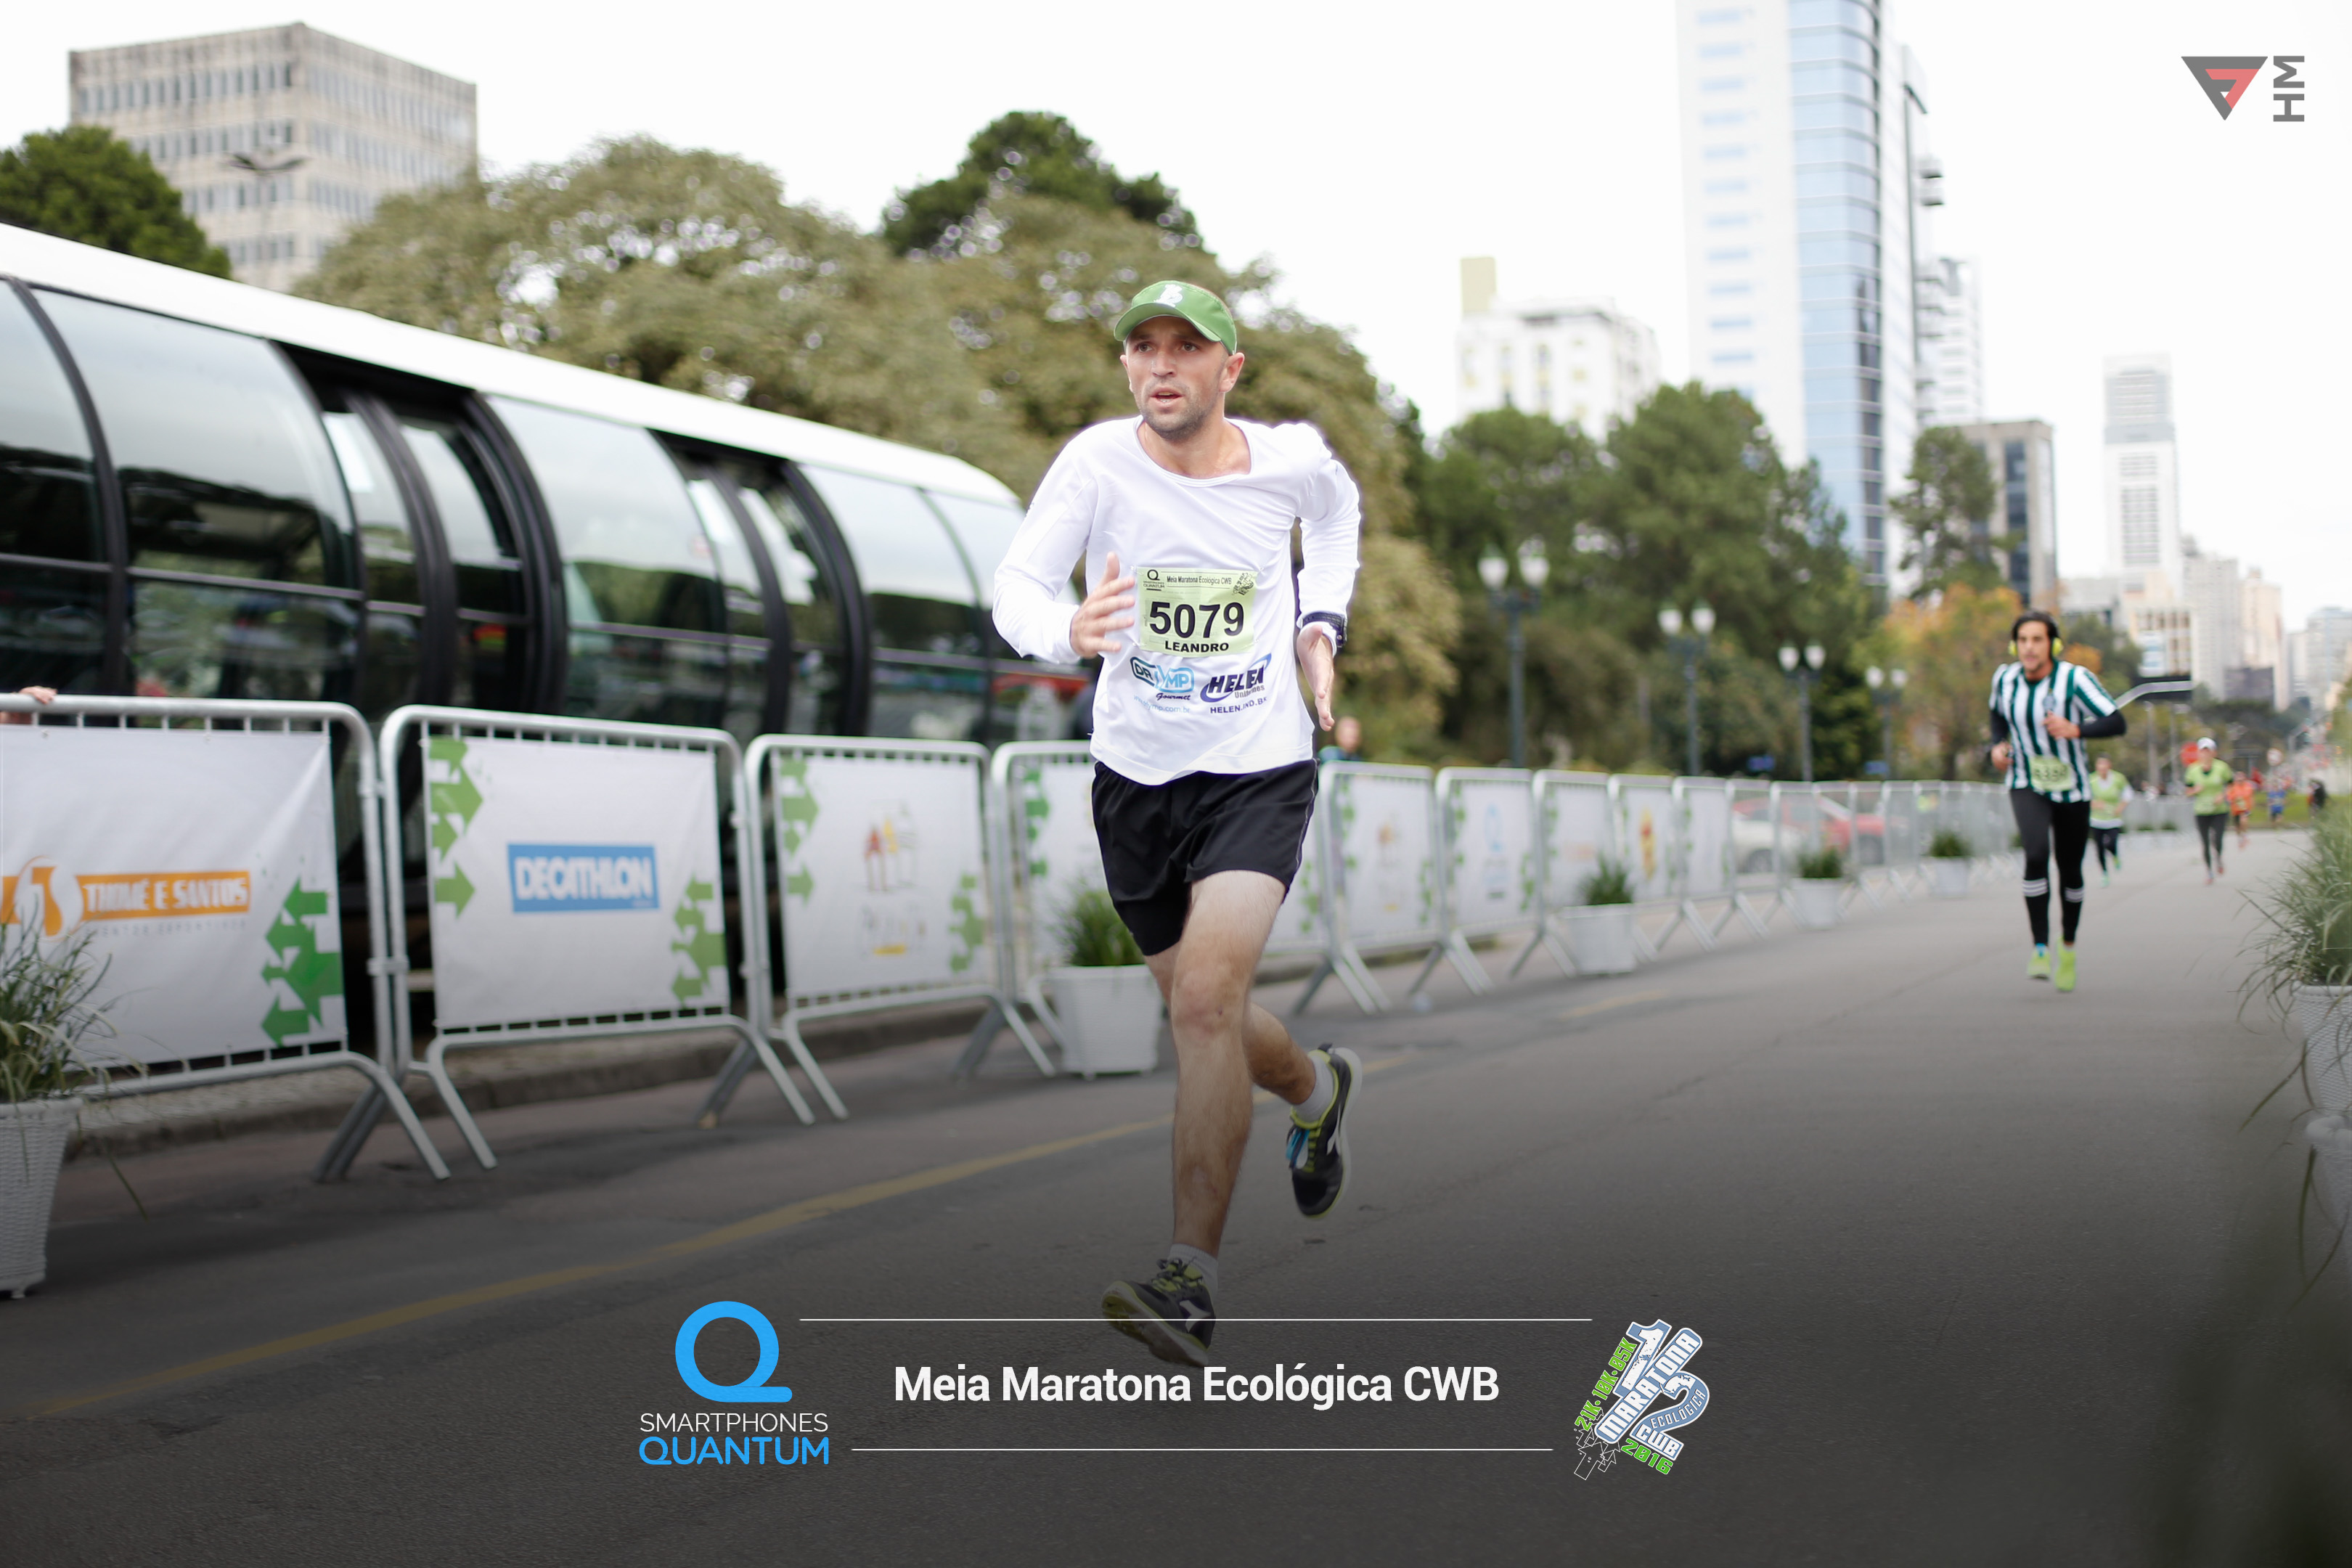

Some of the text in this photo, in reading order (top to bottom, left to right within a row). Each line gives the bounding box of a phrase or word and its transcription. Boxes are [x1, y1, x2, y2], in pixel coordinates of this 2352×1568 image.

[1199, 576, 1220, 585] Ecológica
[1149, 601, 1244, 638] 5079
[1164, 640, 1229, 653] LEANDRO
[154, 880, 169, 910] E
[173, 877, 249, 908] SANTOS
[514, 856, 653, 900] DECATHLON
